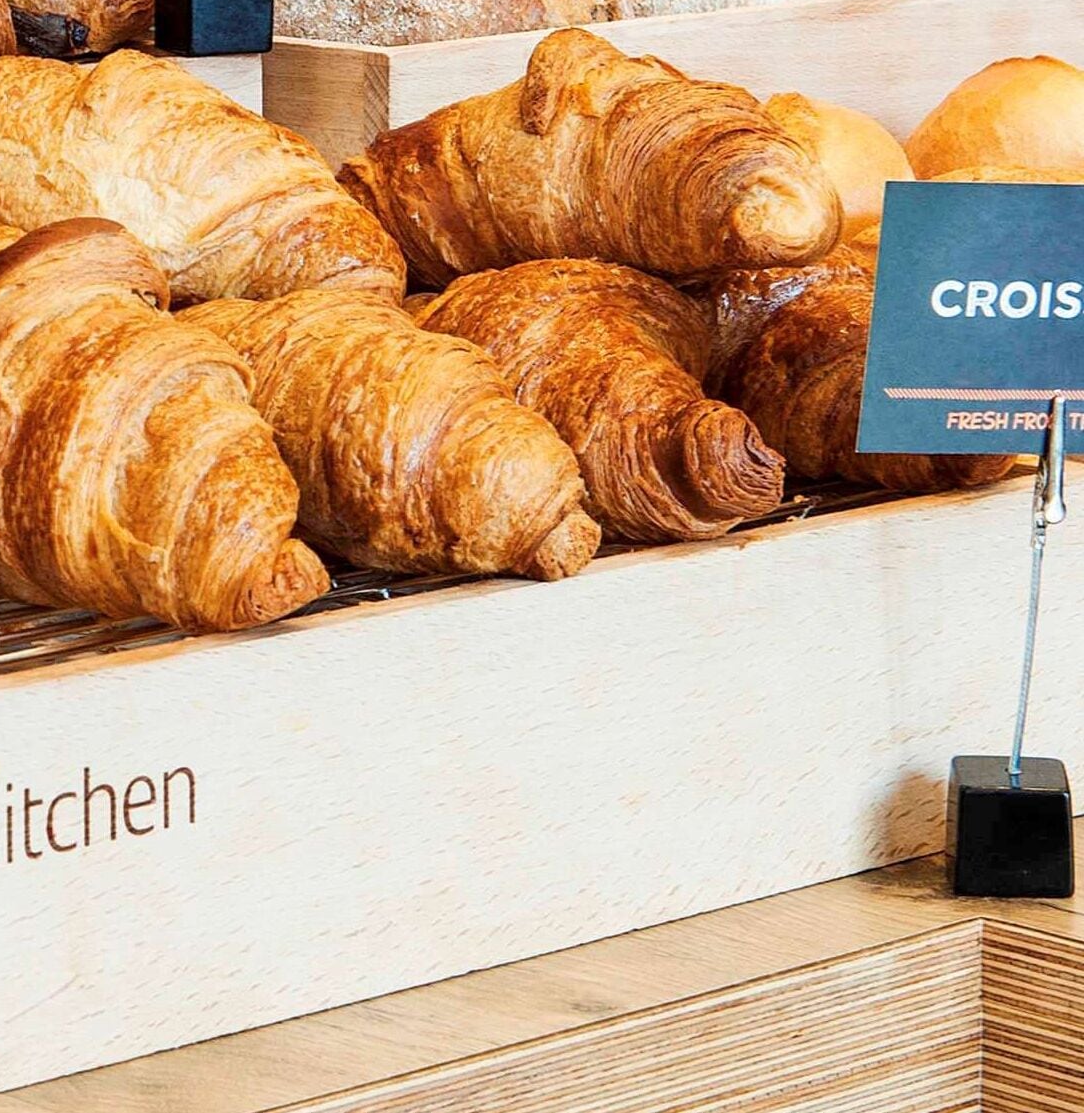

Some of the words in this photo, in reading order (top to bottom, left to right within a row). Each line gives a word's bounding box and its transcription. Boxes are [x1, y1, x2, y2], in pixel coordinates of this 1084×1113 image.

[931, 280, 1084, 319] CROIS
[946, 411, 1010, 430] FRESH
[1012, 412, 1054, 430] FRO
